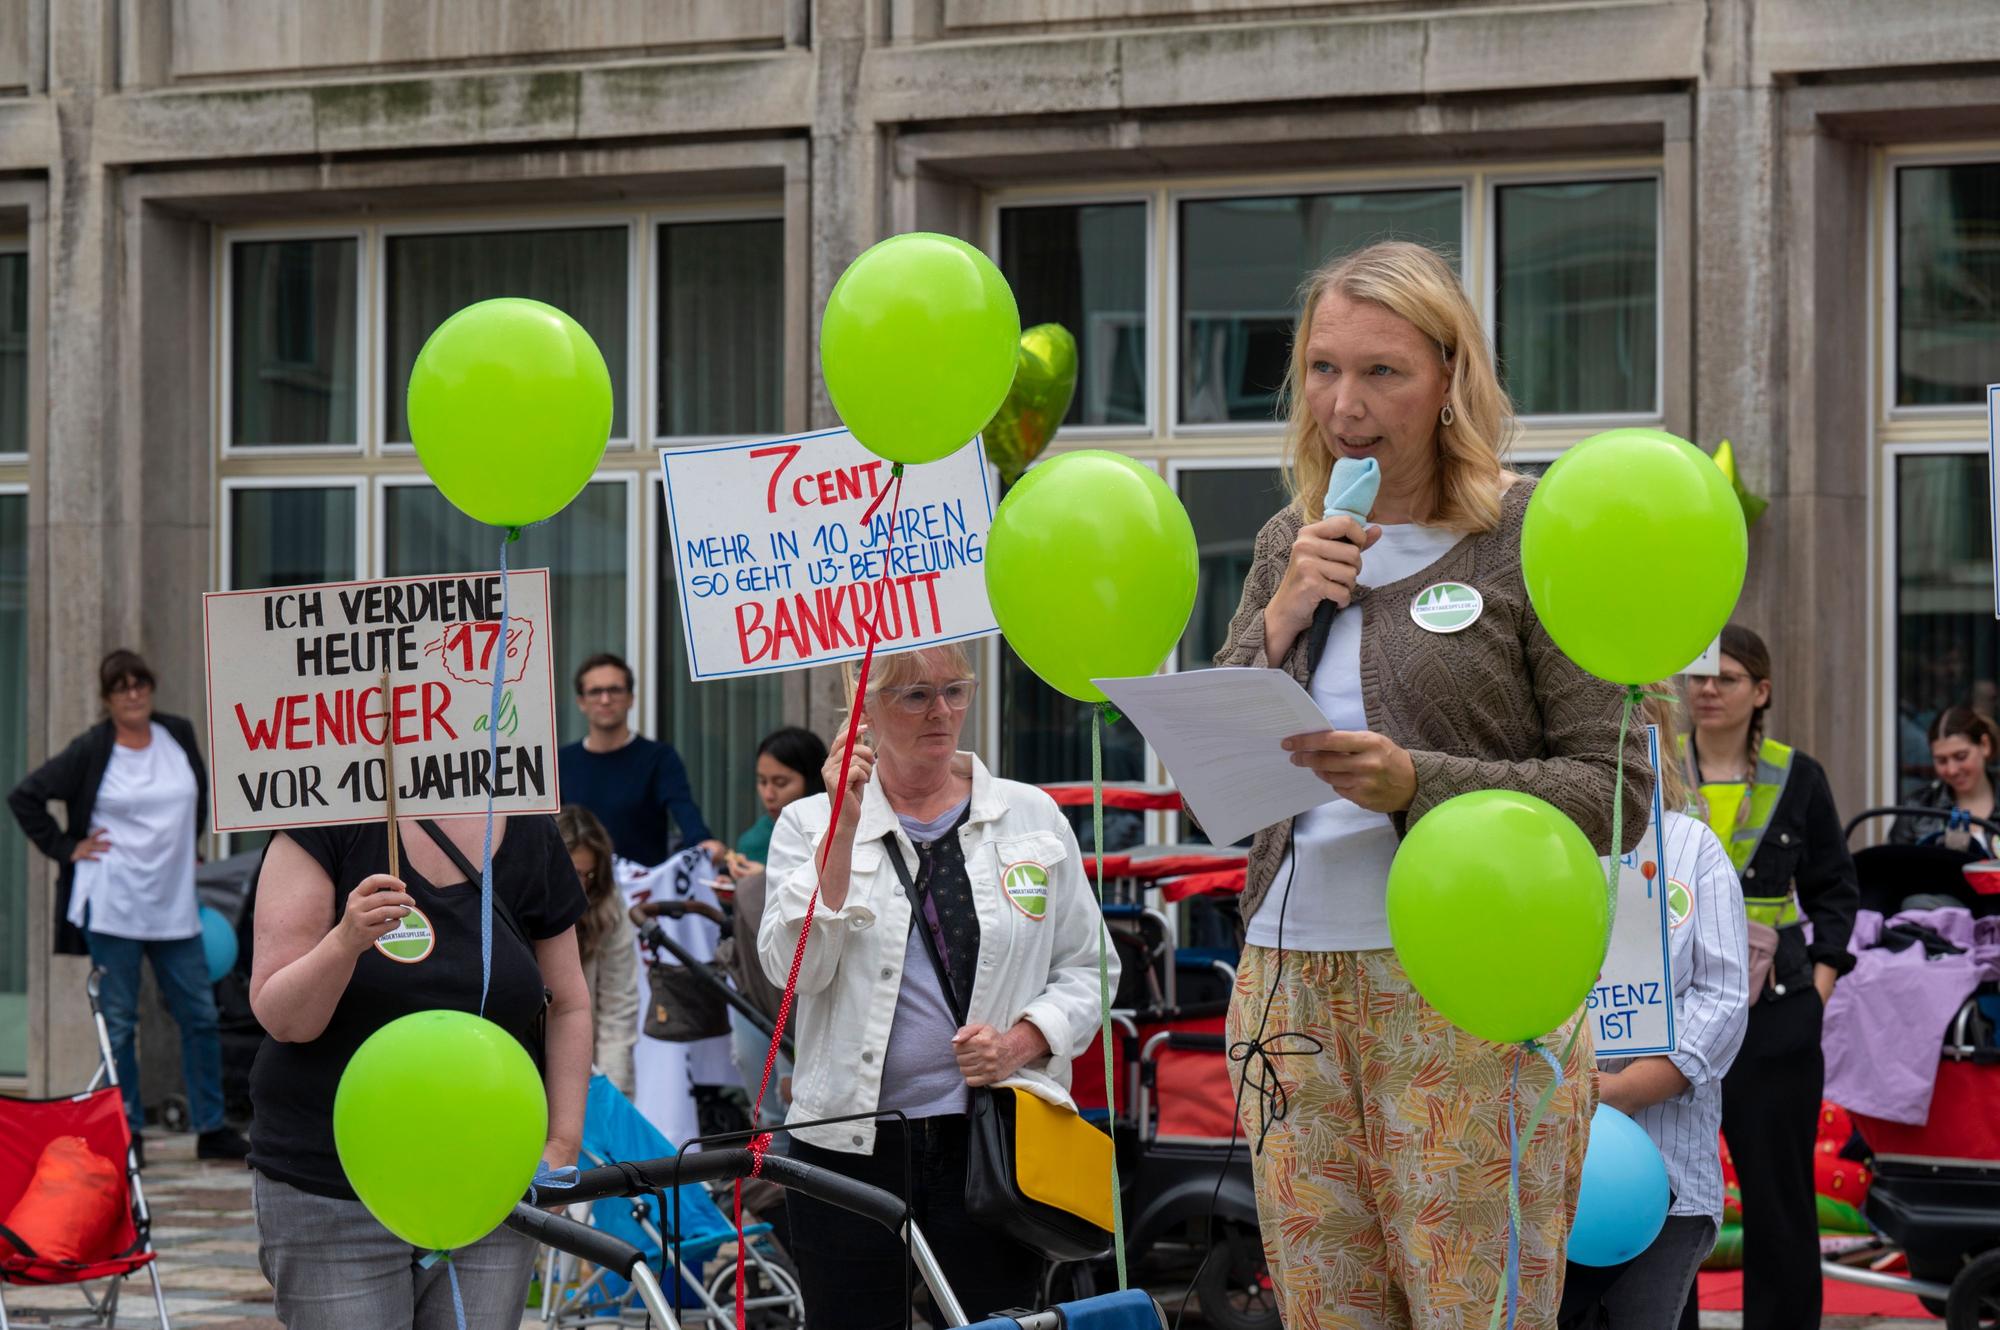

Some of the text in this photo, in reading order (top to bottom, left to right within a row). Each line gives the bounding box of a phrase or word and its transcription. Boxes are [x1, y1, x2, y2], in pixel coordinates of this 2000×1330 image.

[750, 444, 882, 513] 7 CENT
[687, 499, 966, 569] MEHR IN 10 JAHREN
[264, 577, 504, 631] ICH VERDIENE
[692, 574, 729, 598] SO
[736, 563, 792, 592] GEHT
[735, 571, 943, 665] BANKROTT
[297, 626, 418, 677] HEUTE
[234, 681, 518, 751] WENIGER als
[238, 746, 546, 812] VOR 10 JAHREN
[1600, 1010, 1638, 1040] IST
